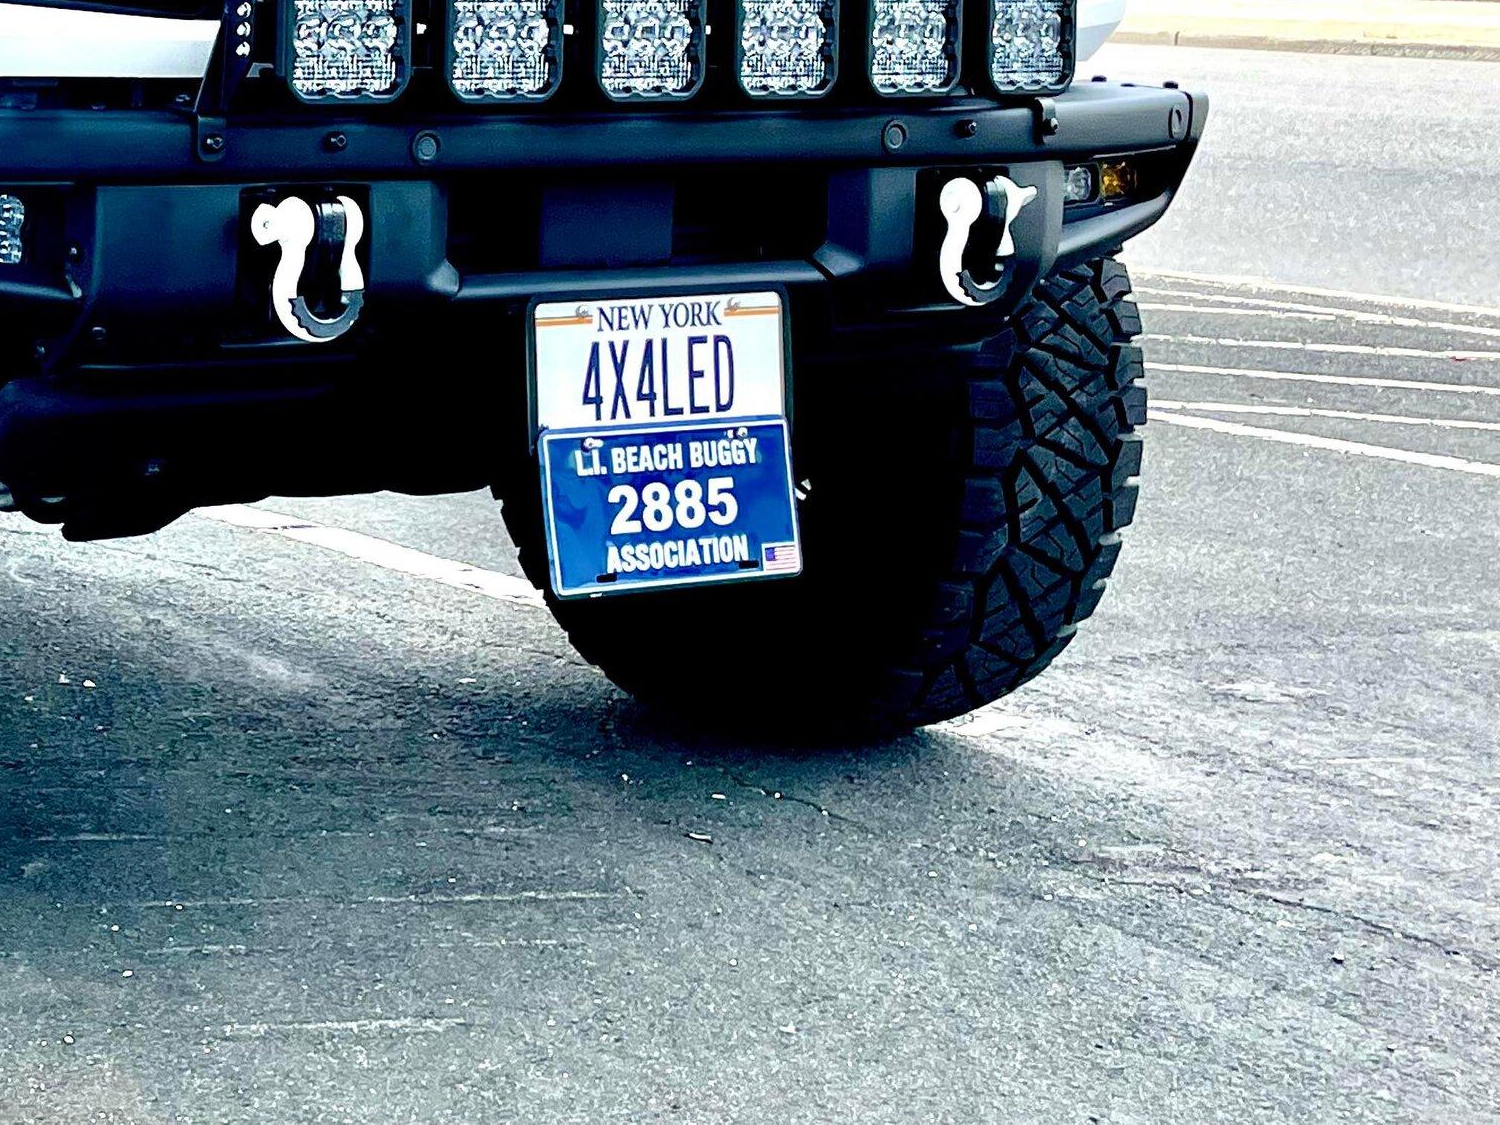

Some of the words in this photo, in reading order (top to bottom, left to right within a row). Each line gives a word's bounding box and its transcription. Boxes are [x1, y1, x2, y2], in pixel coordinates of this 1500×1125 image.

[596, 304, 654, 332] NEW
[662, 301, 722, 327] YORK
[581, 334, 736, 421] 4X4LED
[611, 441, 684, 475] BEACH
[689, 438, 758, 469] BUGGY
[607, 476, 738, 536] 2885
[606, 534, 750, 574] ASSOCIATION
